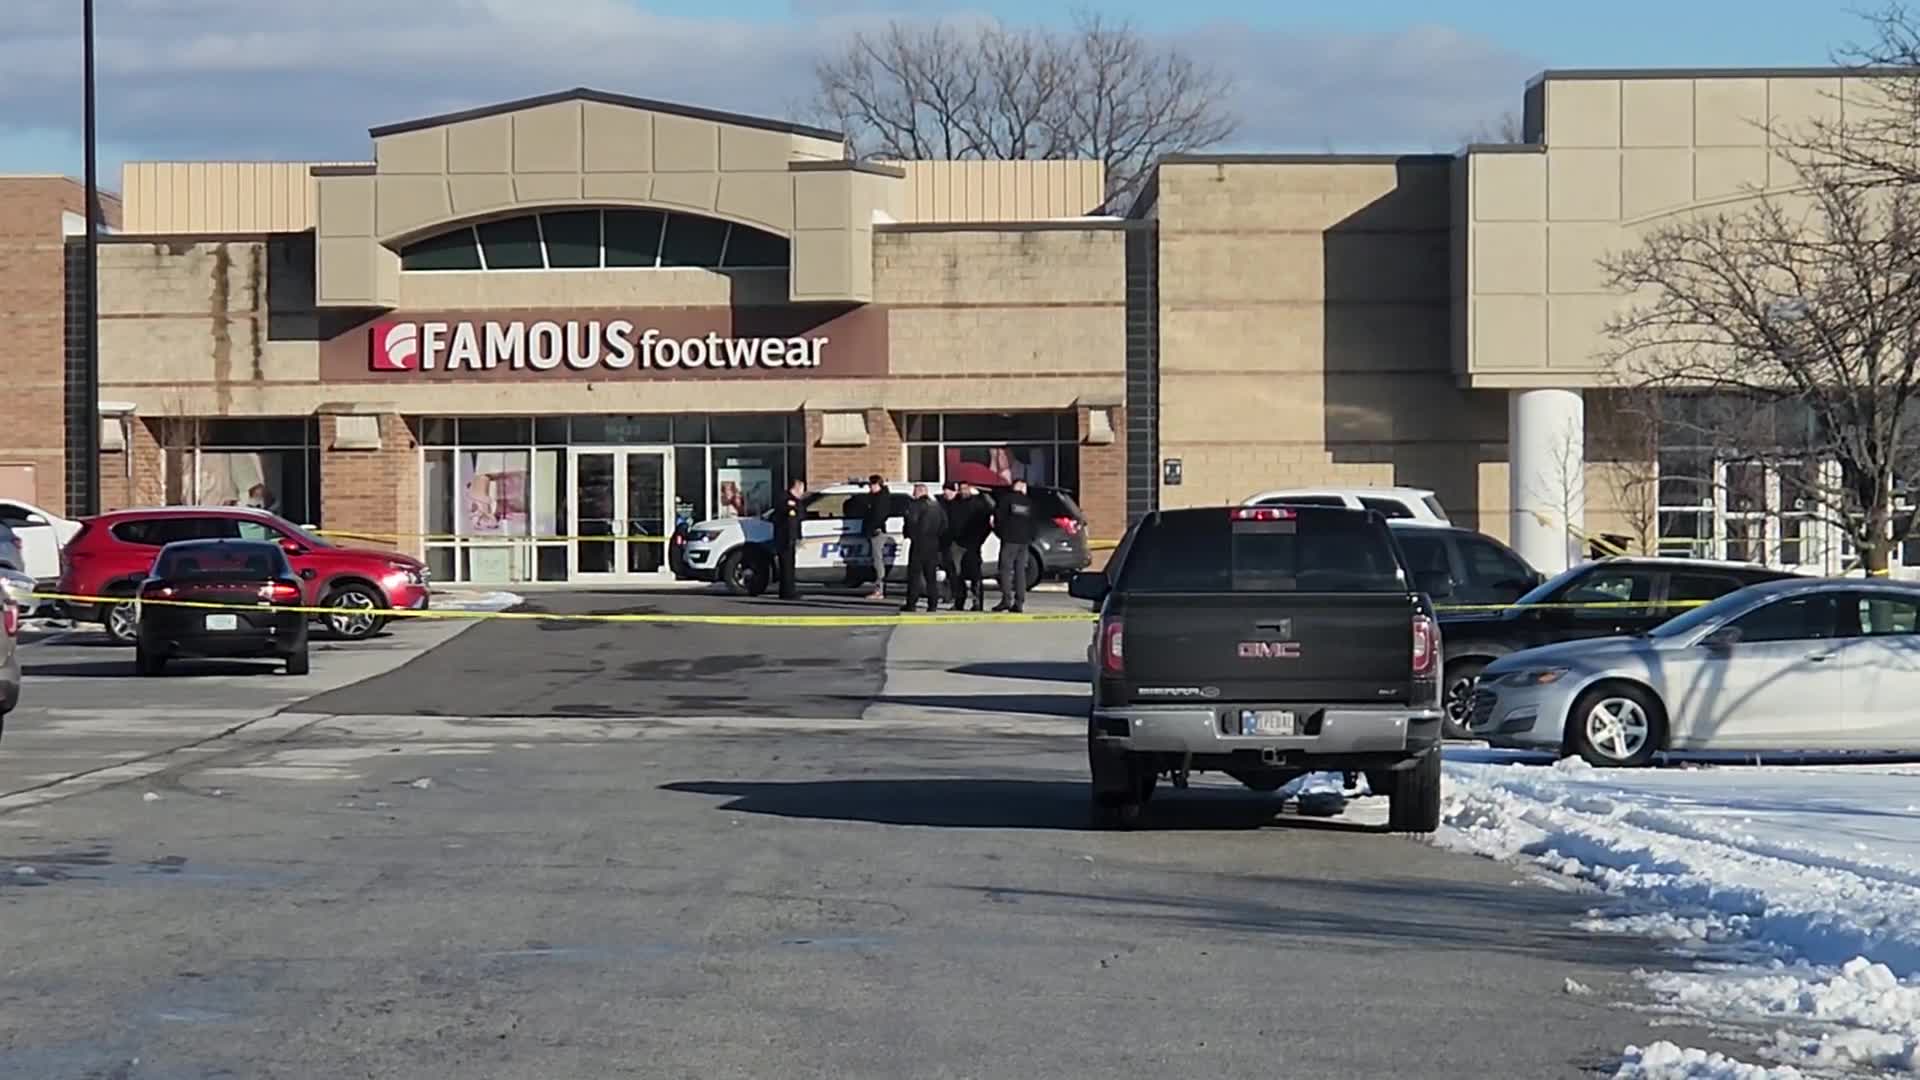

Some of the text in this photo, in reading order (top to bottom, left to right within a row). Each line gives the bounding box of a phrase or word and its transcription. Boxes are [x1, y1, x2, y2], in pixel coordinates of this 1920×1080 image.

[422, 320, 829, 369] FAMOUS footwear
[1237, 642, 1301, 657] GMC
